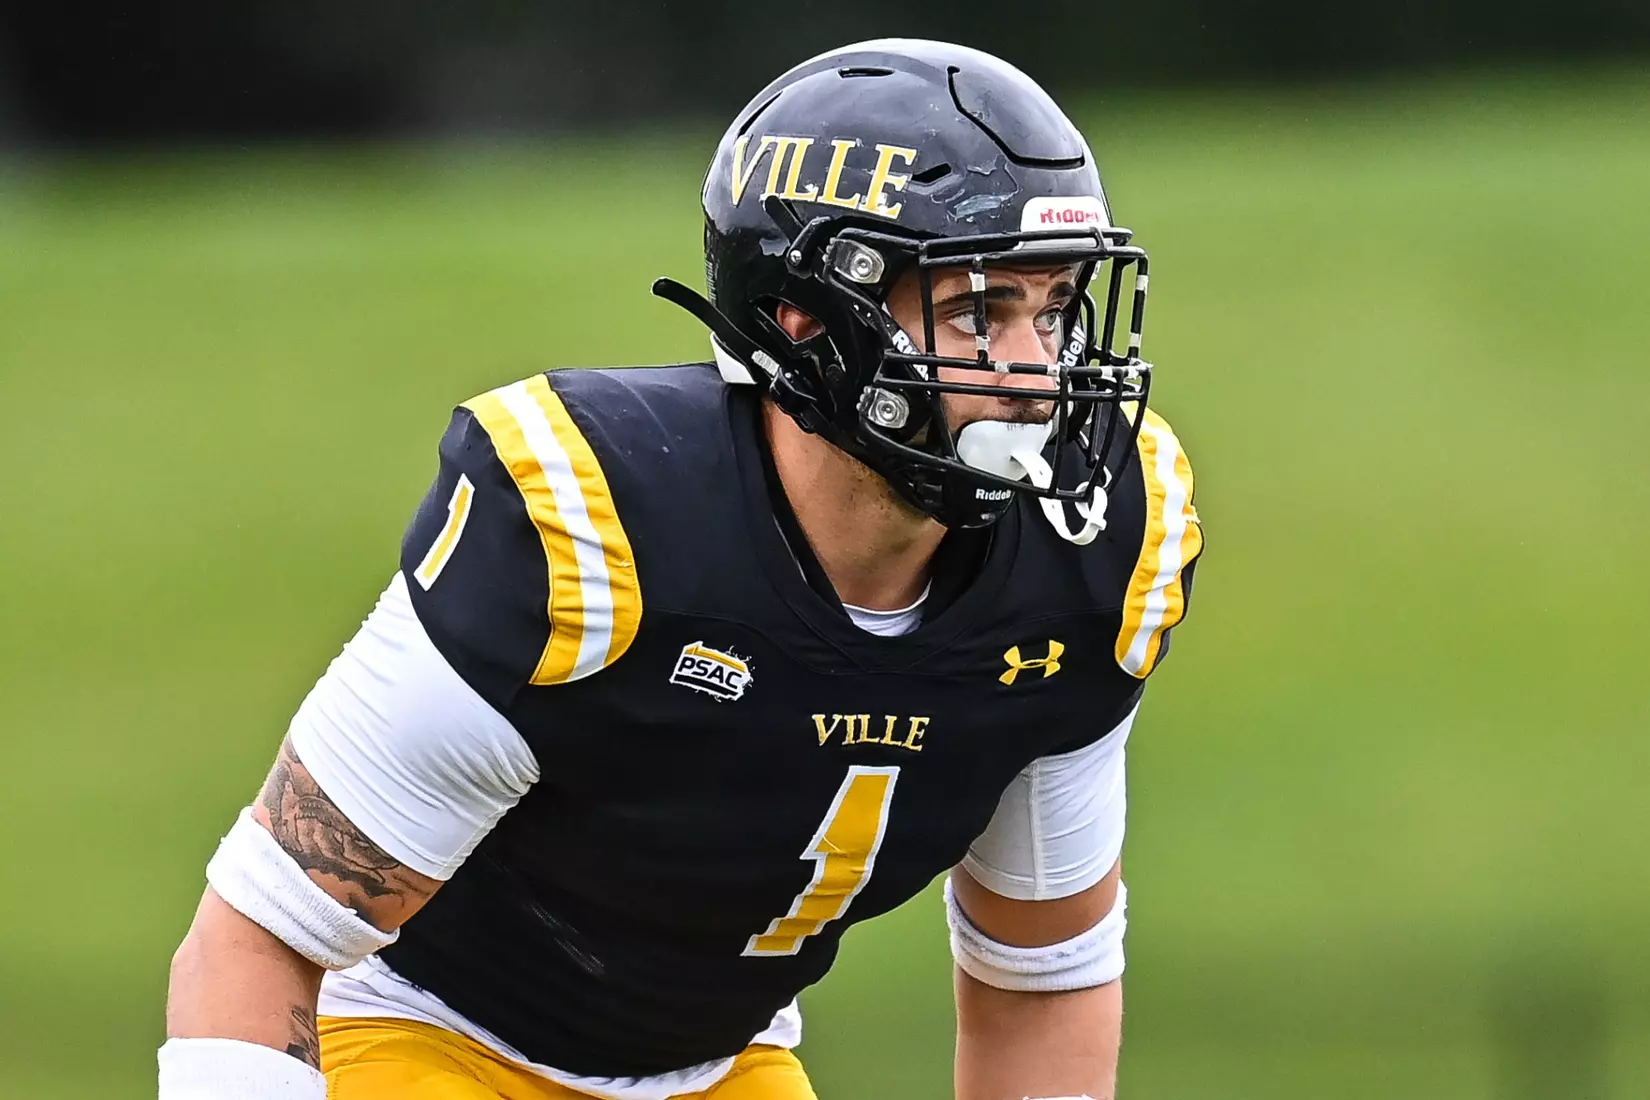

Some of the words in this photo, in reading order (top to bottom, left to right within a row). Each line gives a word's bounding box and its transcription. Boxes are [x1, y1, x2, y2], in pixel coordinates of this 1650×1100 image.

[731, 135, 917, 220] VILLE
[413, 472, 476, 592] 1
[677, 656, 742, 690] PSAC
[811, 714, 930, 752] VILLE
[739, 765, 901, 957] 1
